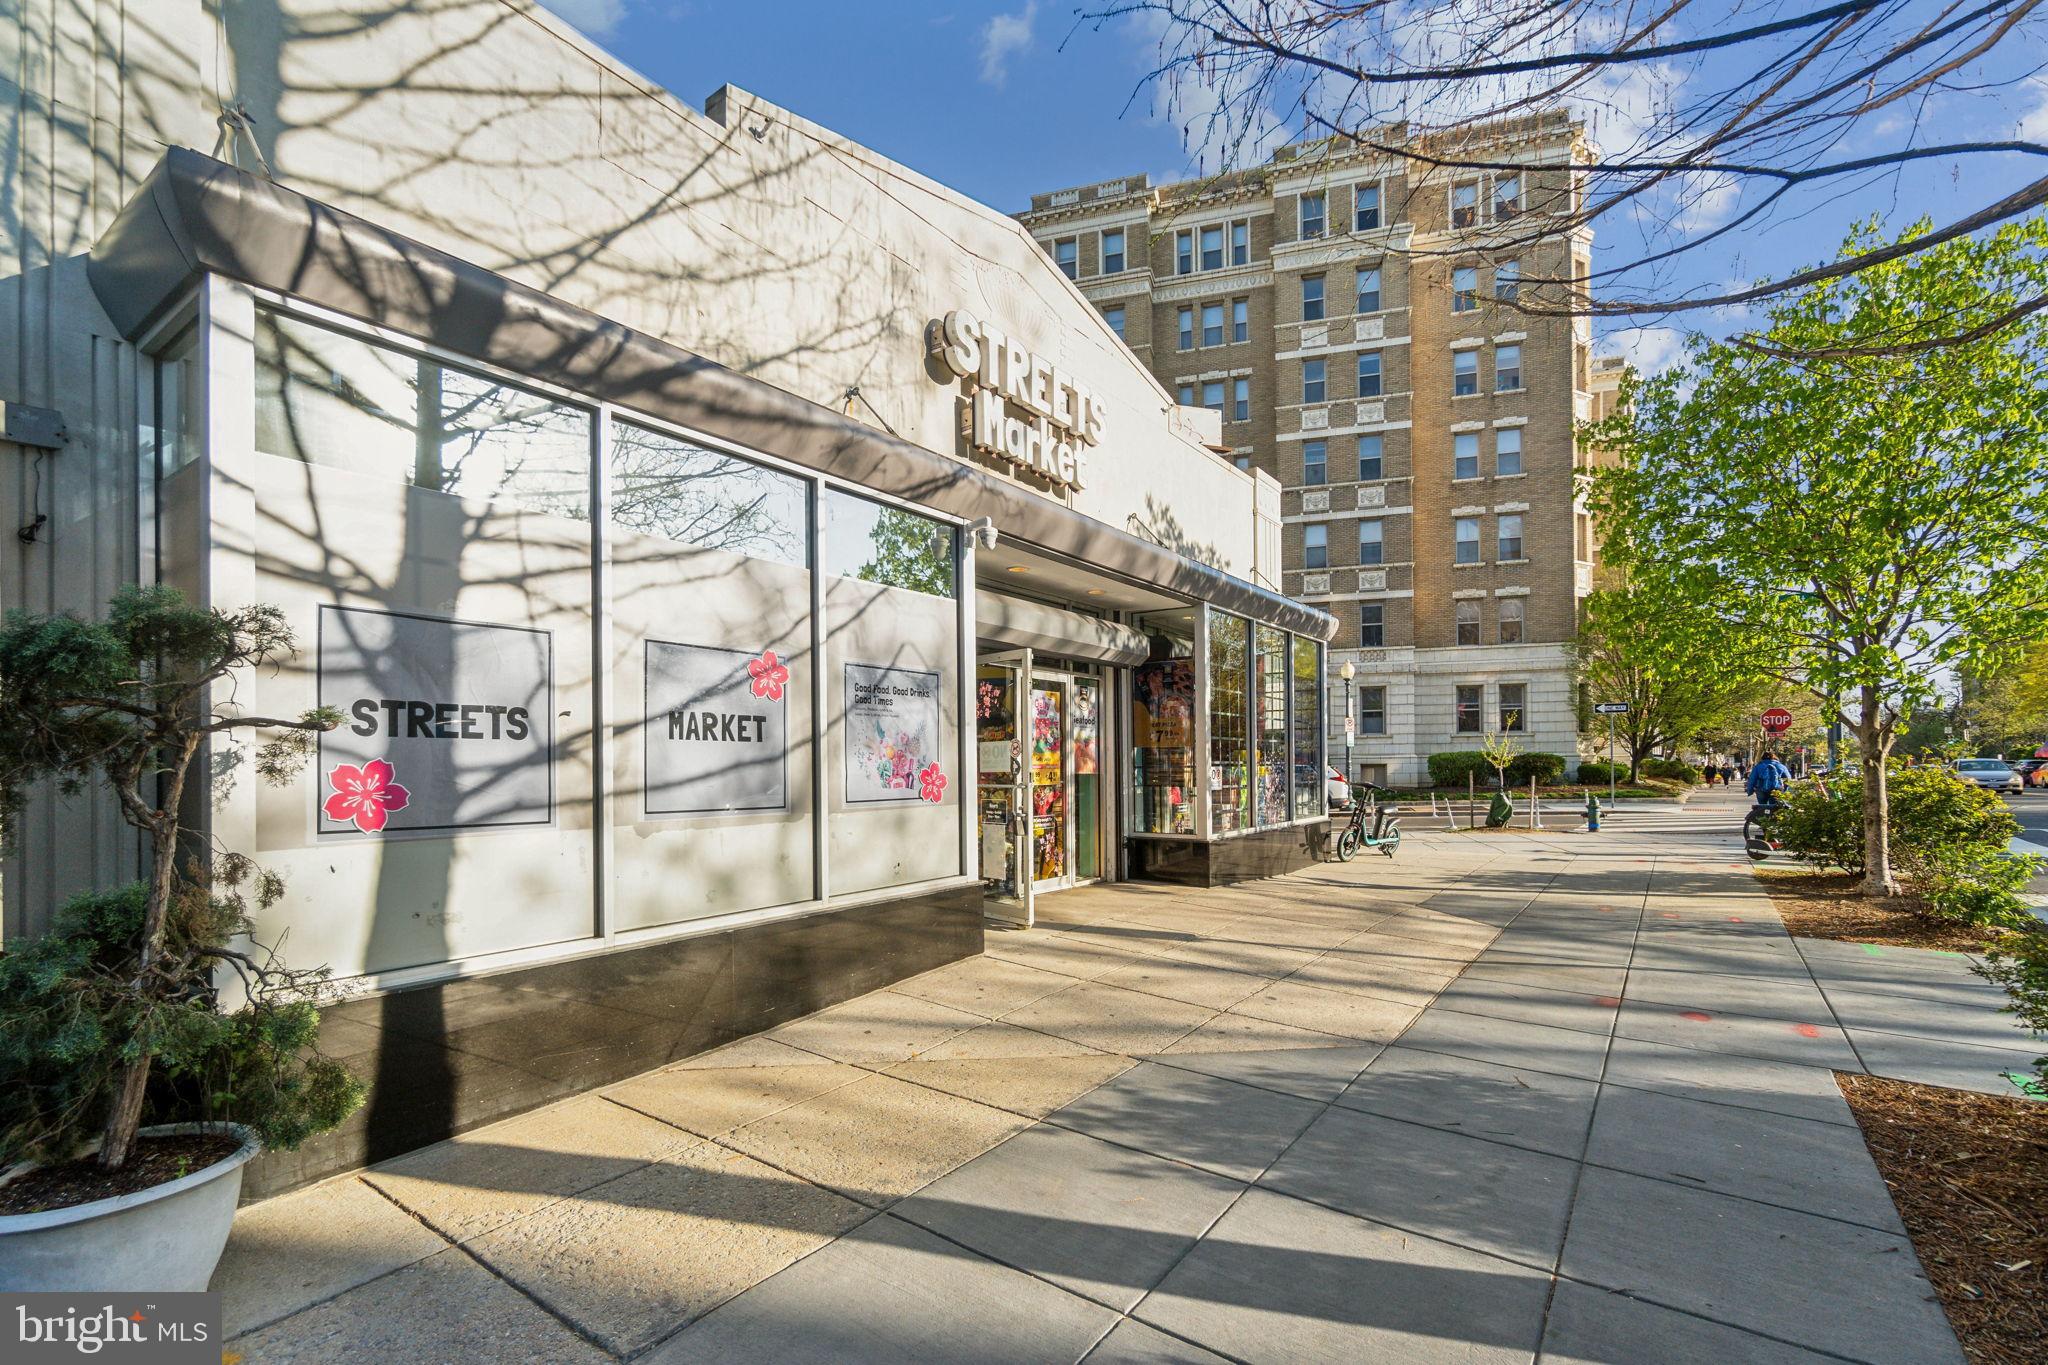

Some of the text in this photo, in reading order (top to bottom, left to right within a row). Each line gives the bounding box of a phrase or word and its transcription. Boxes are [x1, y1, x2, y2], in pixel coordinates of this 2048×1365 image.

[944, 309, 1108, 447] STREETS
[973, 389, 1088, 493] Market
[854, 682, 871, 693] Good
[892, 686, 909, 696] Good
[854, 694, 893, 706] Good Times
[351, 698, 529, 741] STREETS
[668, 710, 767, 742] MARKET
[1762, 715, 1790, 725] STOP
